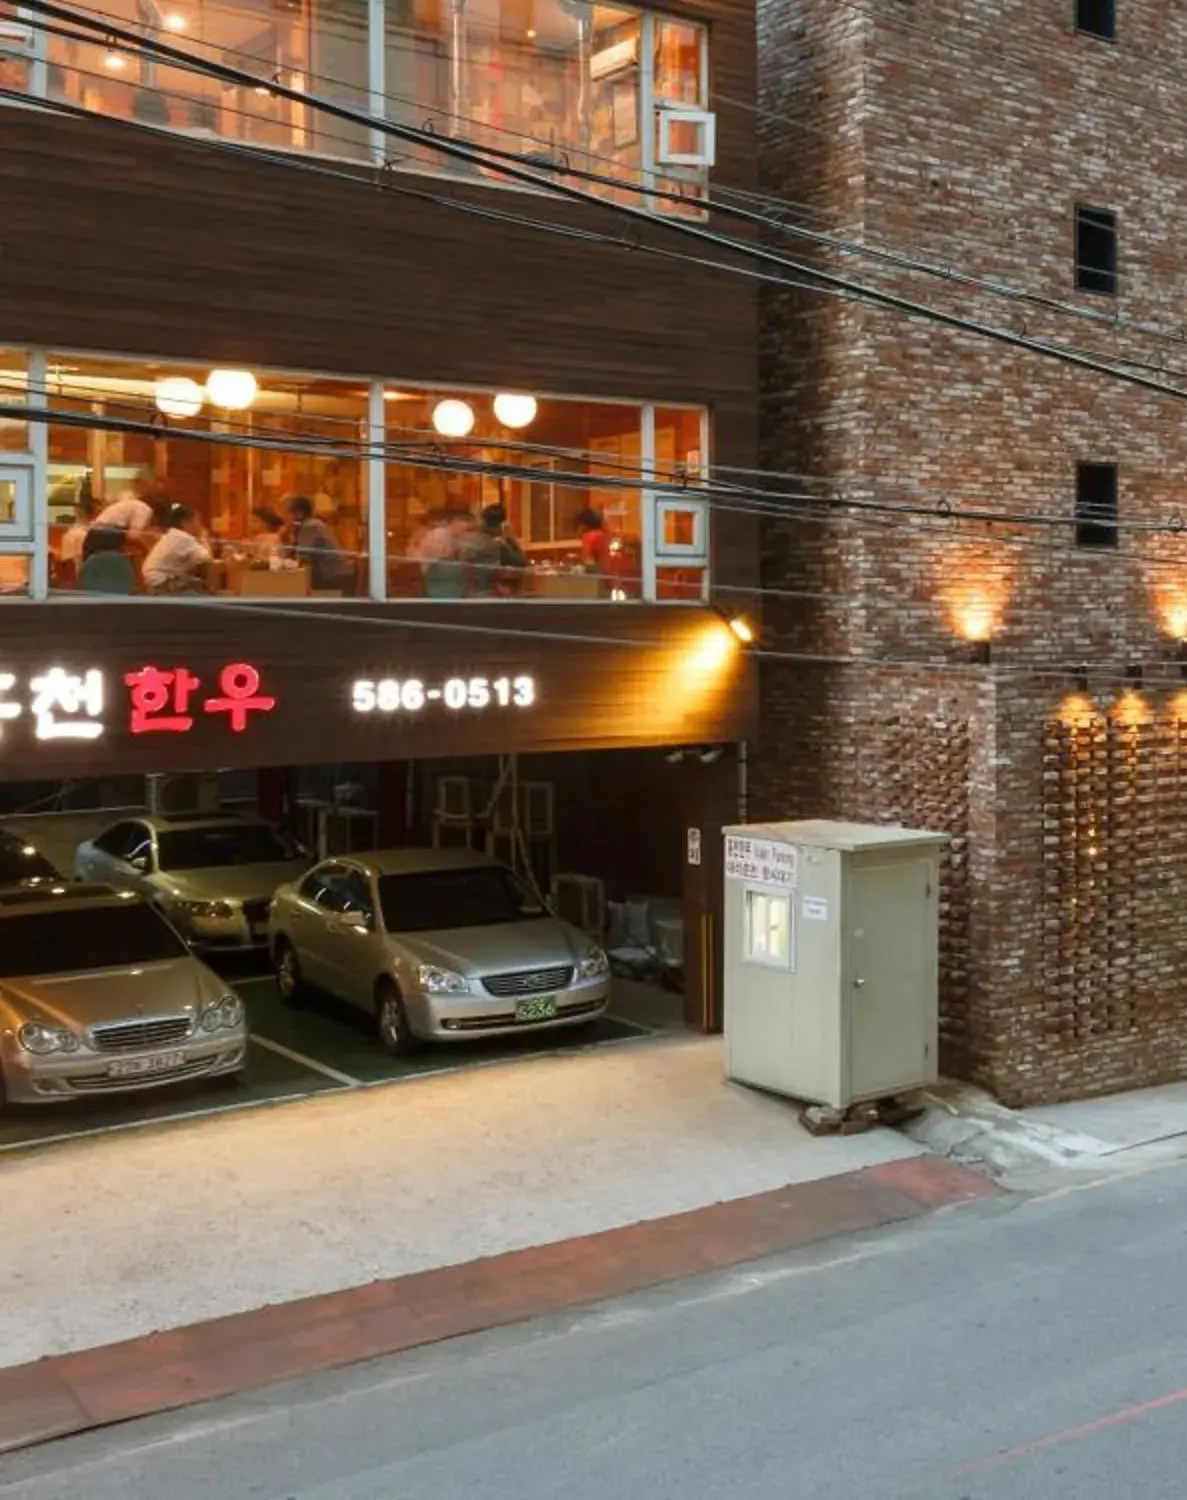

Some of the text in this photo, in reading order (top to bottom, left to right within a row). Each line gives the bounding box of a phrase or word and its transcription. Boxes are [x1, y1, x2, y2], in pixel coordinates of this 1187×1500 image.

[0, 663, 275, 740] 천 한우
[352, 676, 535, 712] 586-0513
